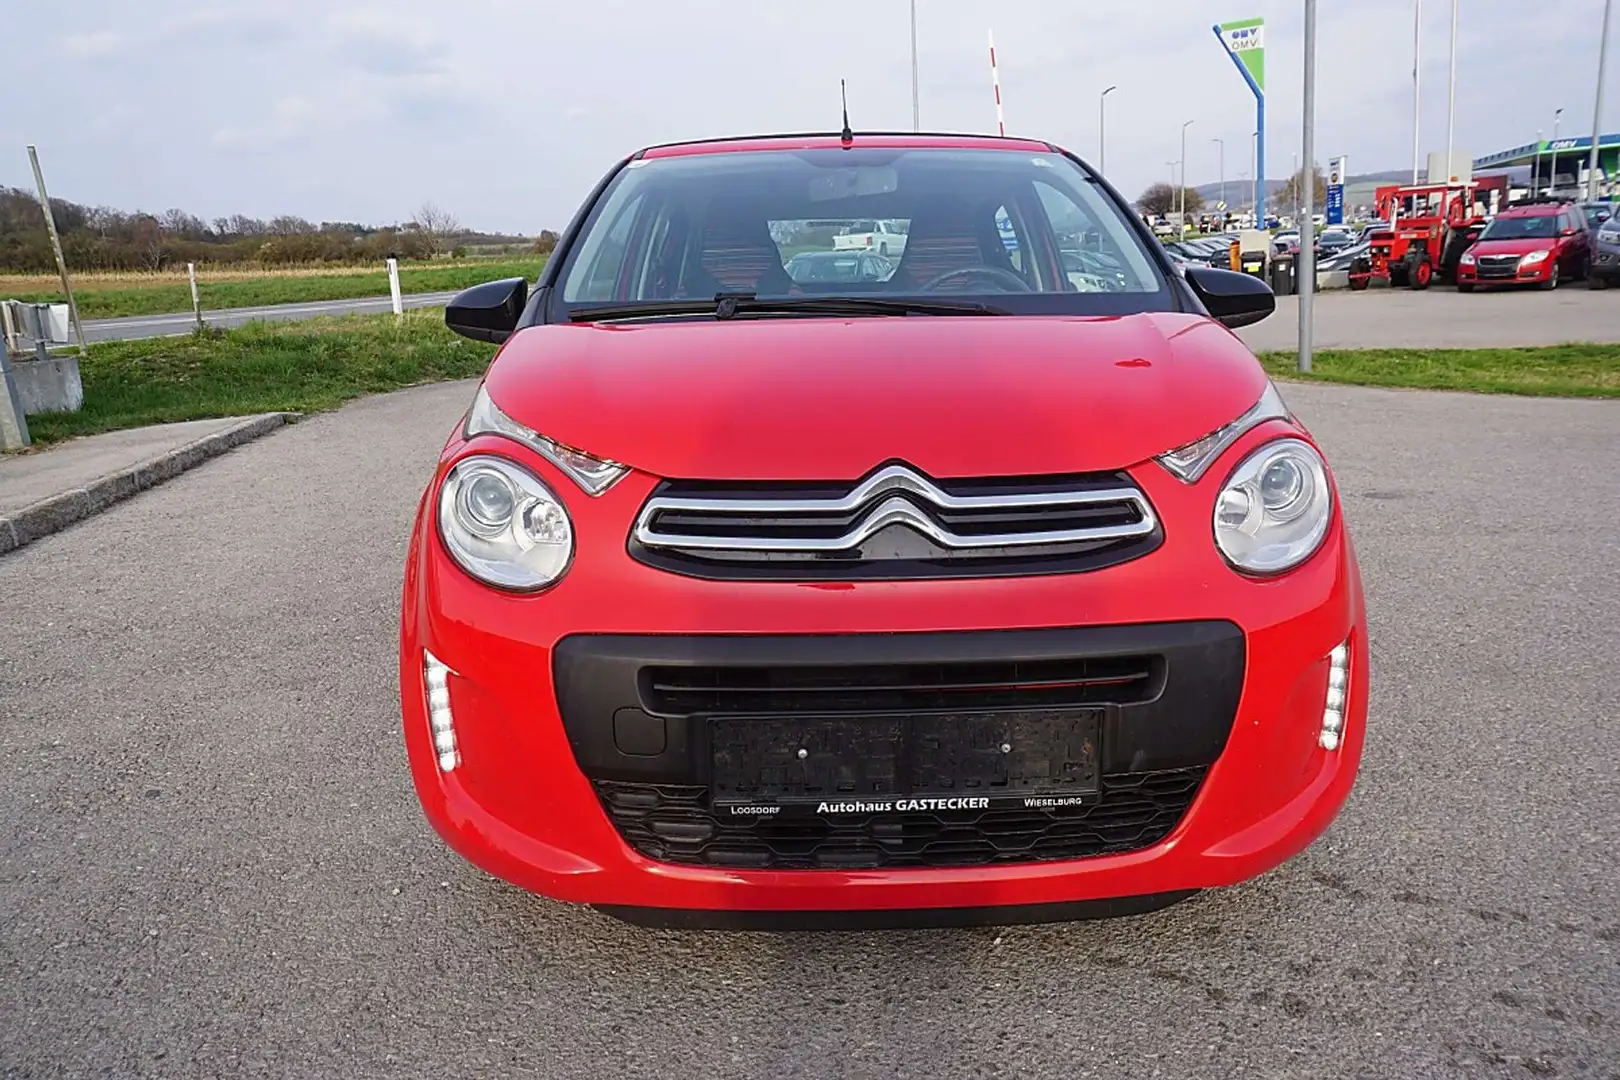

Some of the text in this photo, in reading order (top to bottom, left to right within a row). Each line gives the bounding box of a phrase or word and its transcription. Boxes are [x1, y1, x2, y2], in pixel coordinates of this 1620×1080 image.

[1231, 38, 1258, 50] OMV
[1551, 139, 1578, 150] OMV
[816, 797, 990, 813] Autohaus GASTECKER
[1024, 797, 1082, 807] WIESELBURG
